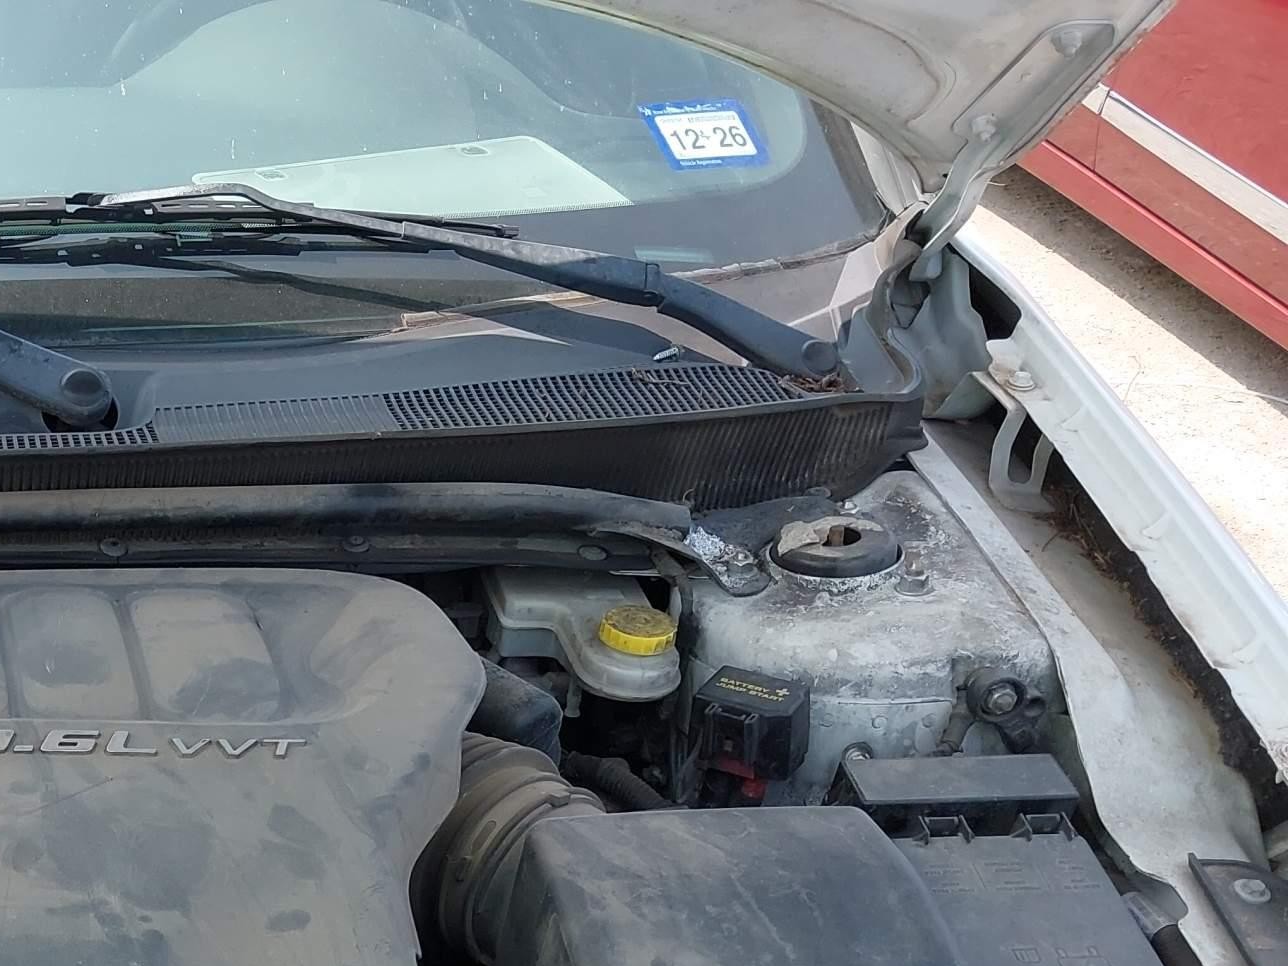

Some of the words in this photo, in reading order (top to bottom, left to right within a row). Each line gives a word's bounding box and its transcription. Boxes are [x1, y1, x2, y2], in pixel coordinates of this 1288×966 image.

[670, 128, 706, 150] 12
[712, 126, 748, 148] 26
[715, 682, 747, 692] JUMP
[748, 690, 785, 702] START
[720, 677, 771, 693] BATTERY
[168, 738, 308, 760] VVT
